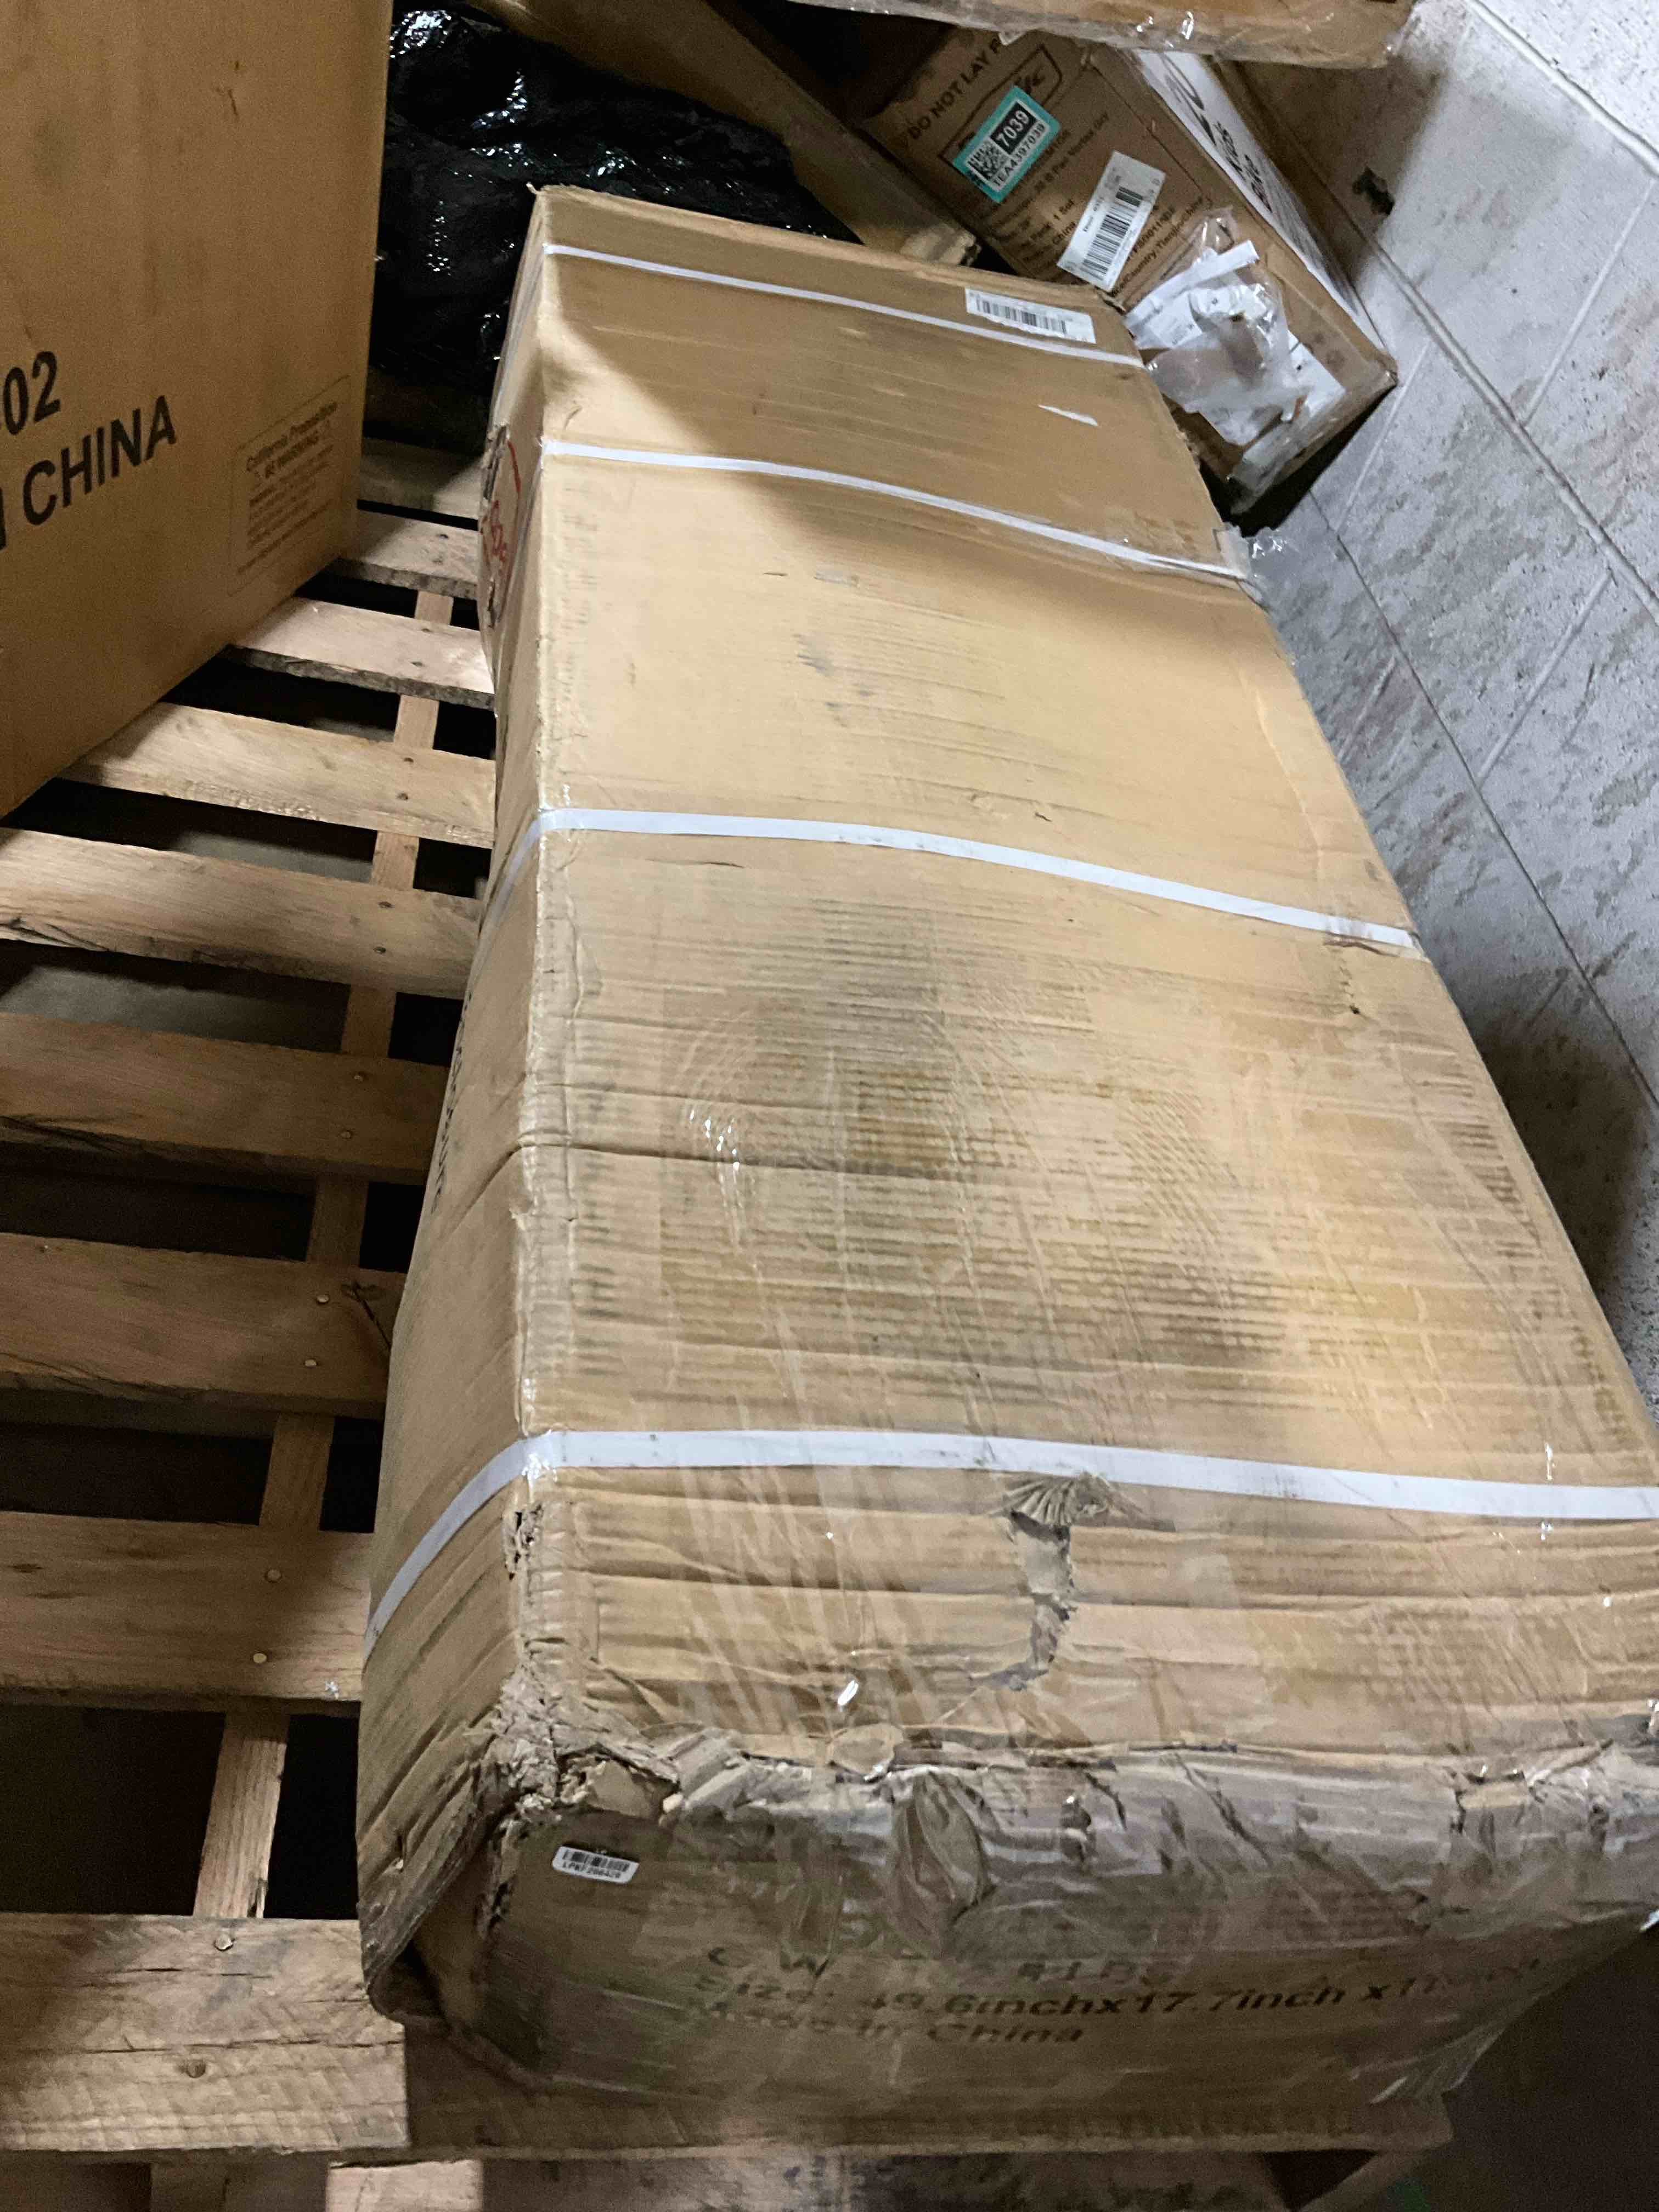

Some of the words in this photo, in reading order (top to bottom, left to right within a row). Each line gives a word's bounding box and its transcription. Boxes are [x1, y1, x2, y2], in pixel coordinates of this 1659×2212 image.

[908, 115, 932, 141] DO
[929, 81, 964, 117] NOT
[961, 53, 991, 84] LAY
[997, 110, 1030, 148] 7039
[993, 122, 1046, 187] TEA4397039
[0, 351, 61, 436] 02
[22, 394, 177, 527] CHINA
